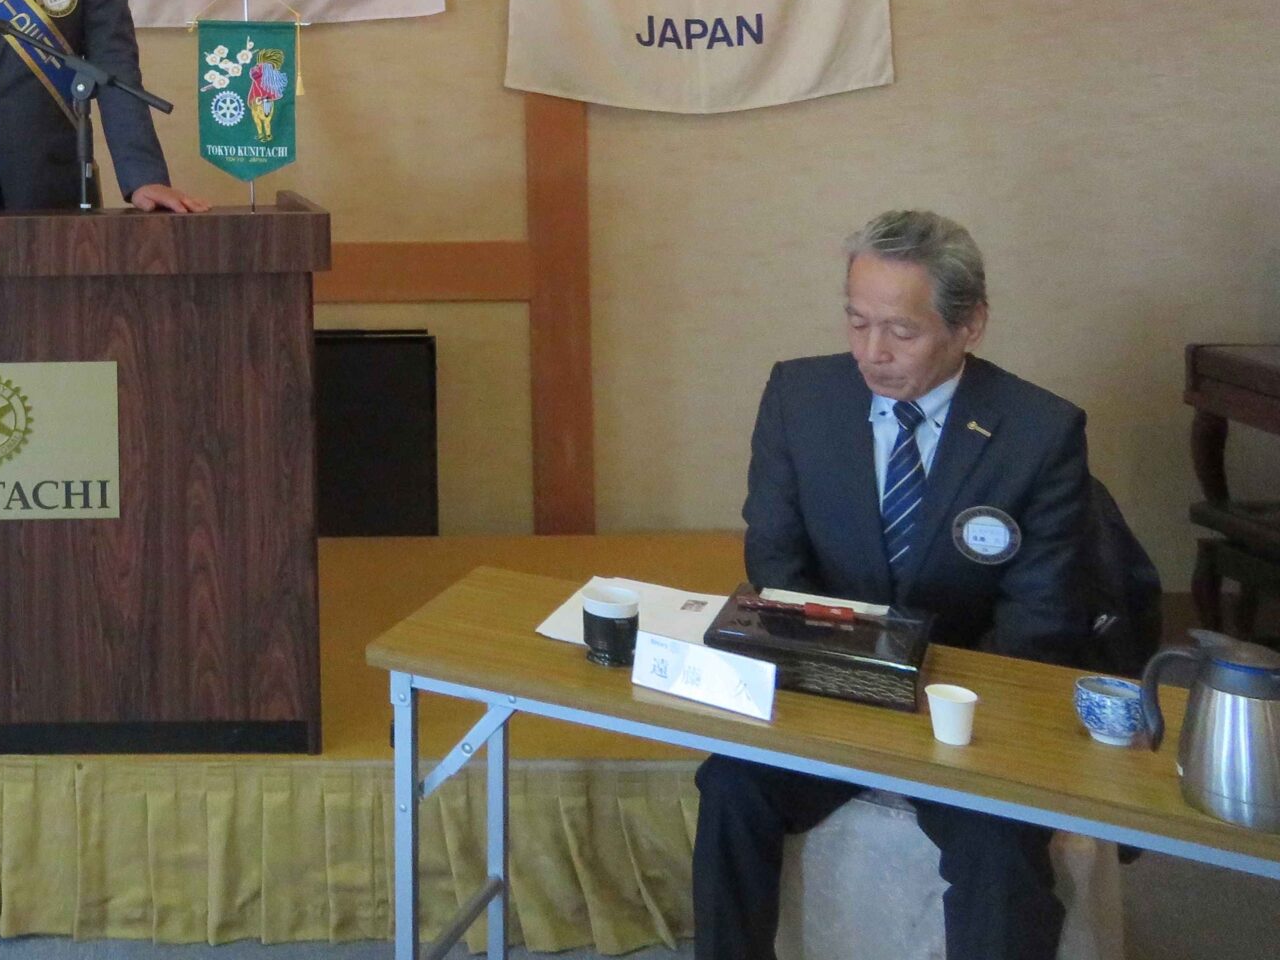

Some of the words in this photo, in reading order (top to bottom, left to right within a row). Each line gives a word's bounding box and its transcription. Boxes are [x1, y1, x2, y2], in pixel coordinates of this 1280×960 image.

[636, 13, 763, 49] JAPAN
[206, 145, 236, 156] TOKYO
[237, 146, 288, 158] KUNITACHI
